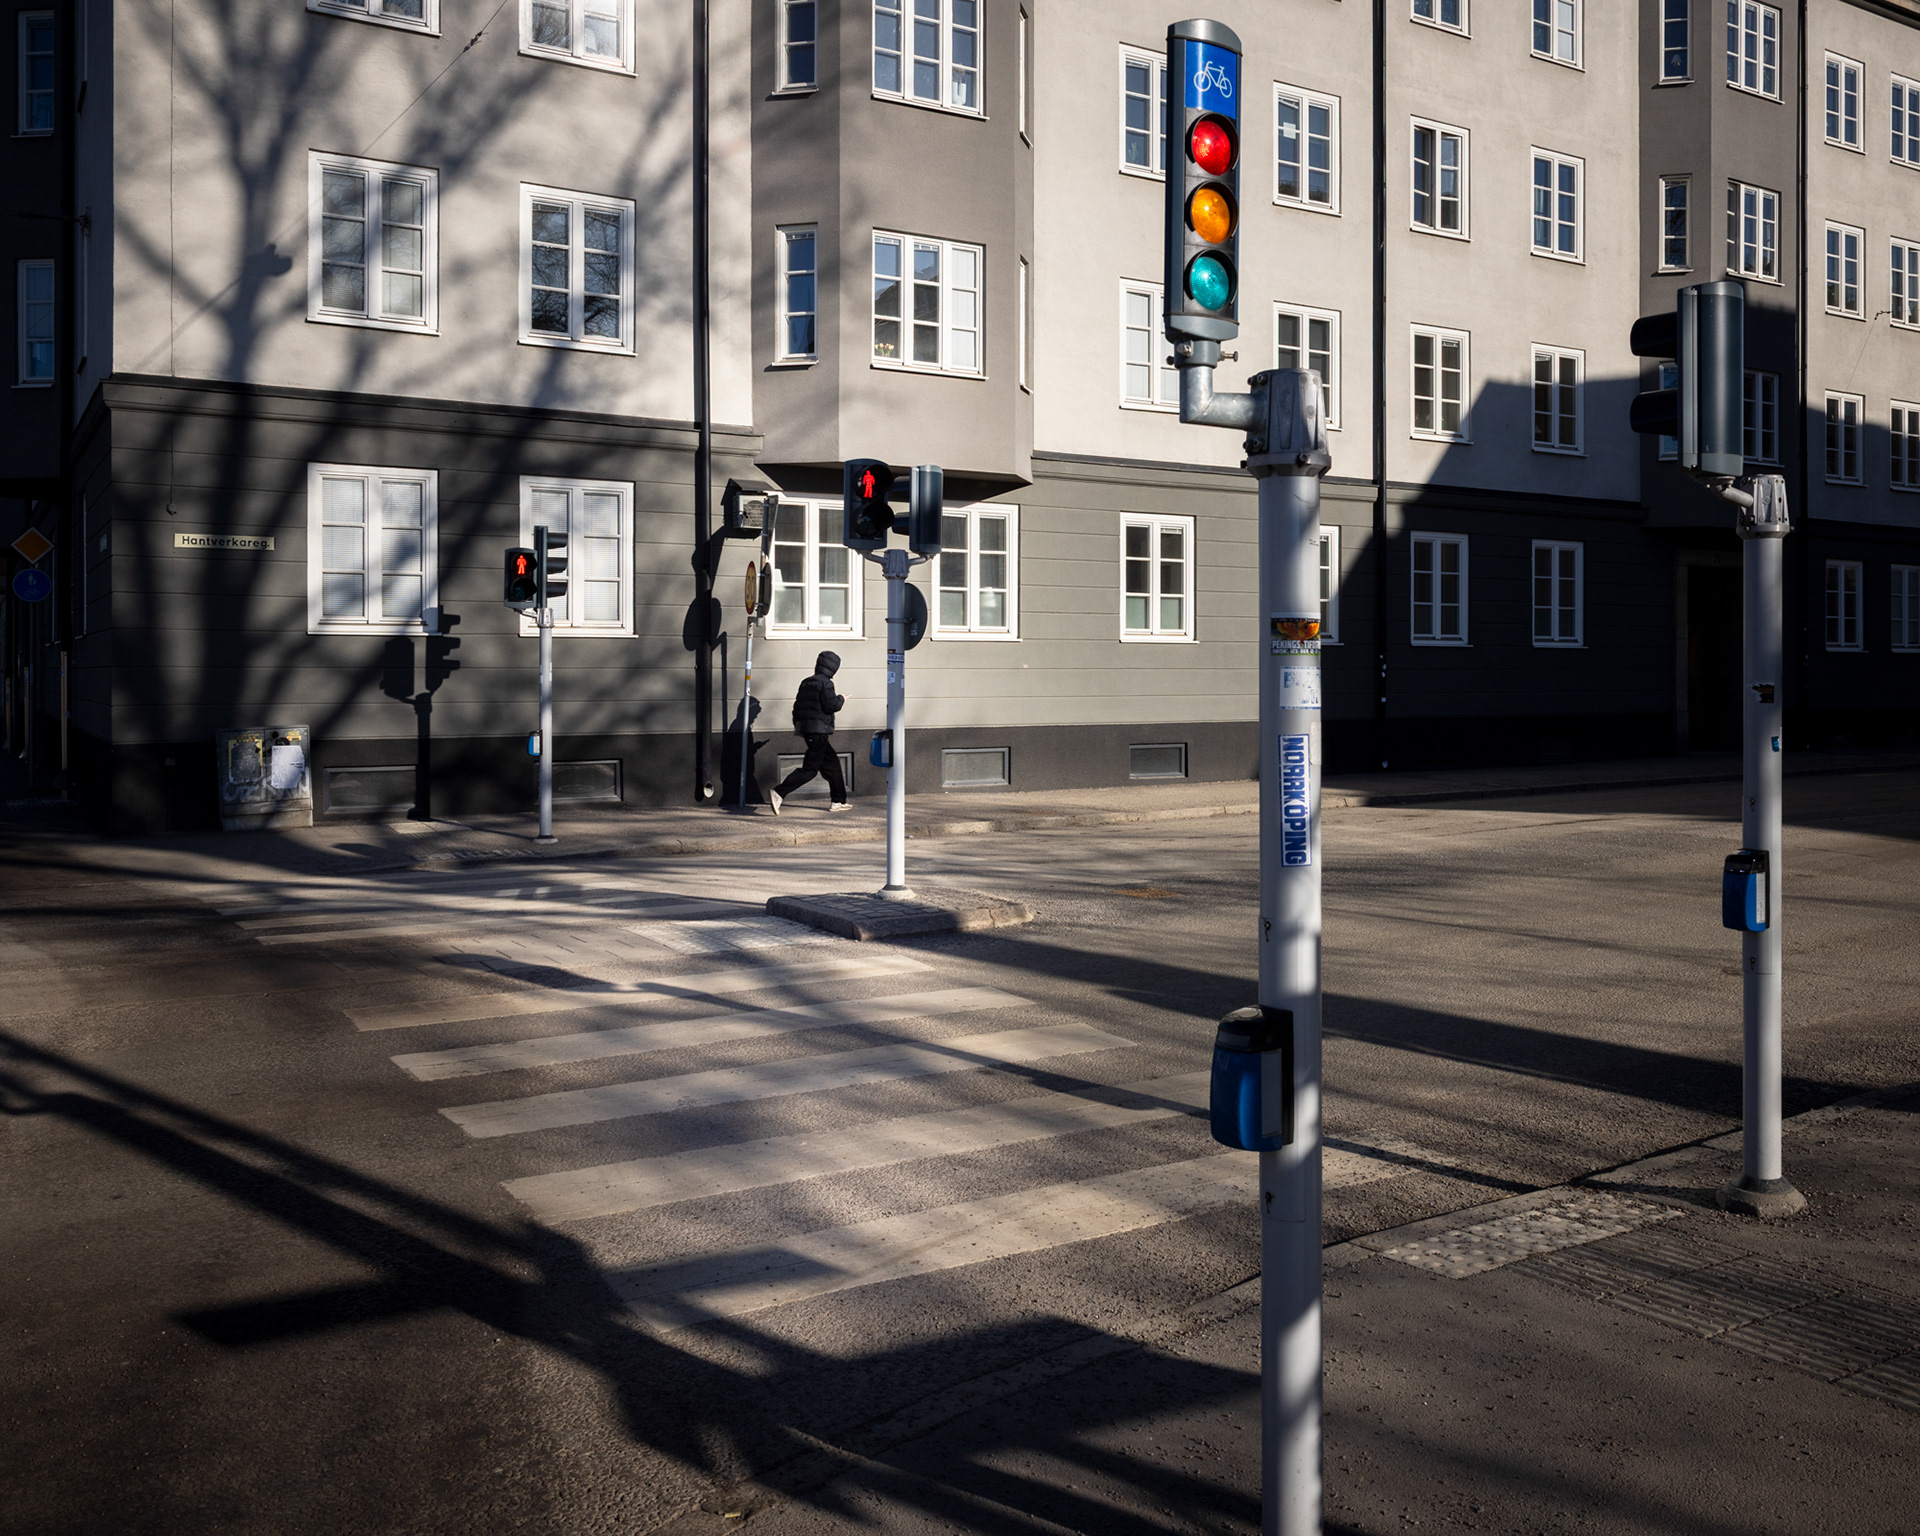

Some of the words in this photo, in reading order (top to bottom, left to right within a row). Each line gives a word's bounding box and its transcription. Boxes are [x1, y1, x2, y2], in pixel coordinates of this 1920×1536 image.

[182, 536, 270, 549] Hantverkareg.
[1272, 640, 1301, 649] PEKINGS
[1282, 737, 1308, 864] NORRKÖPING
